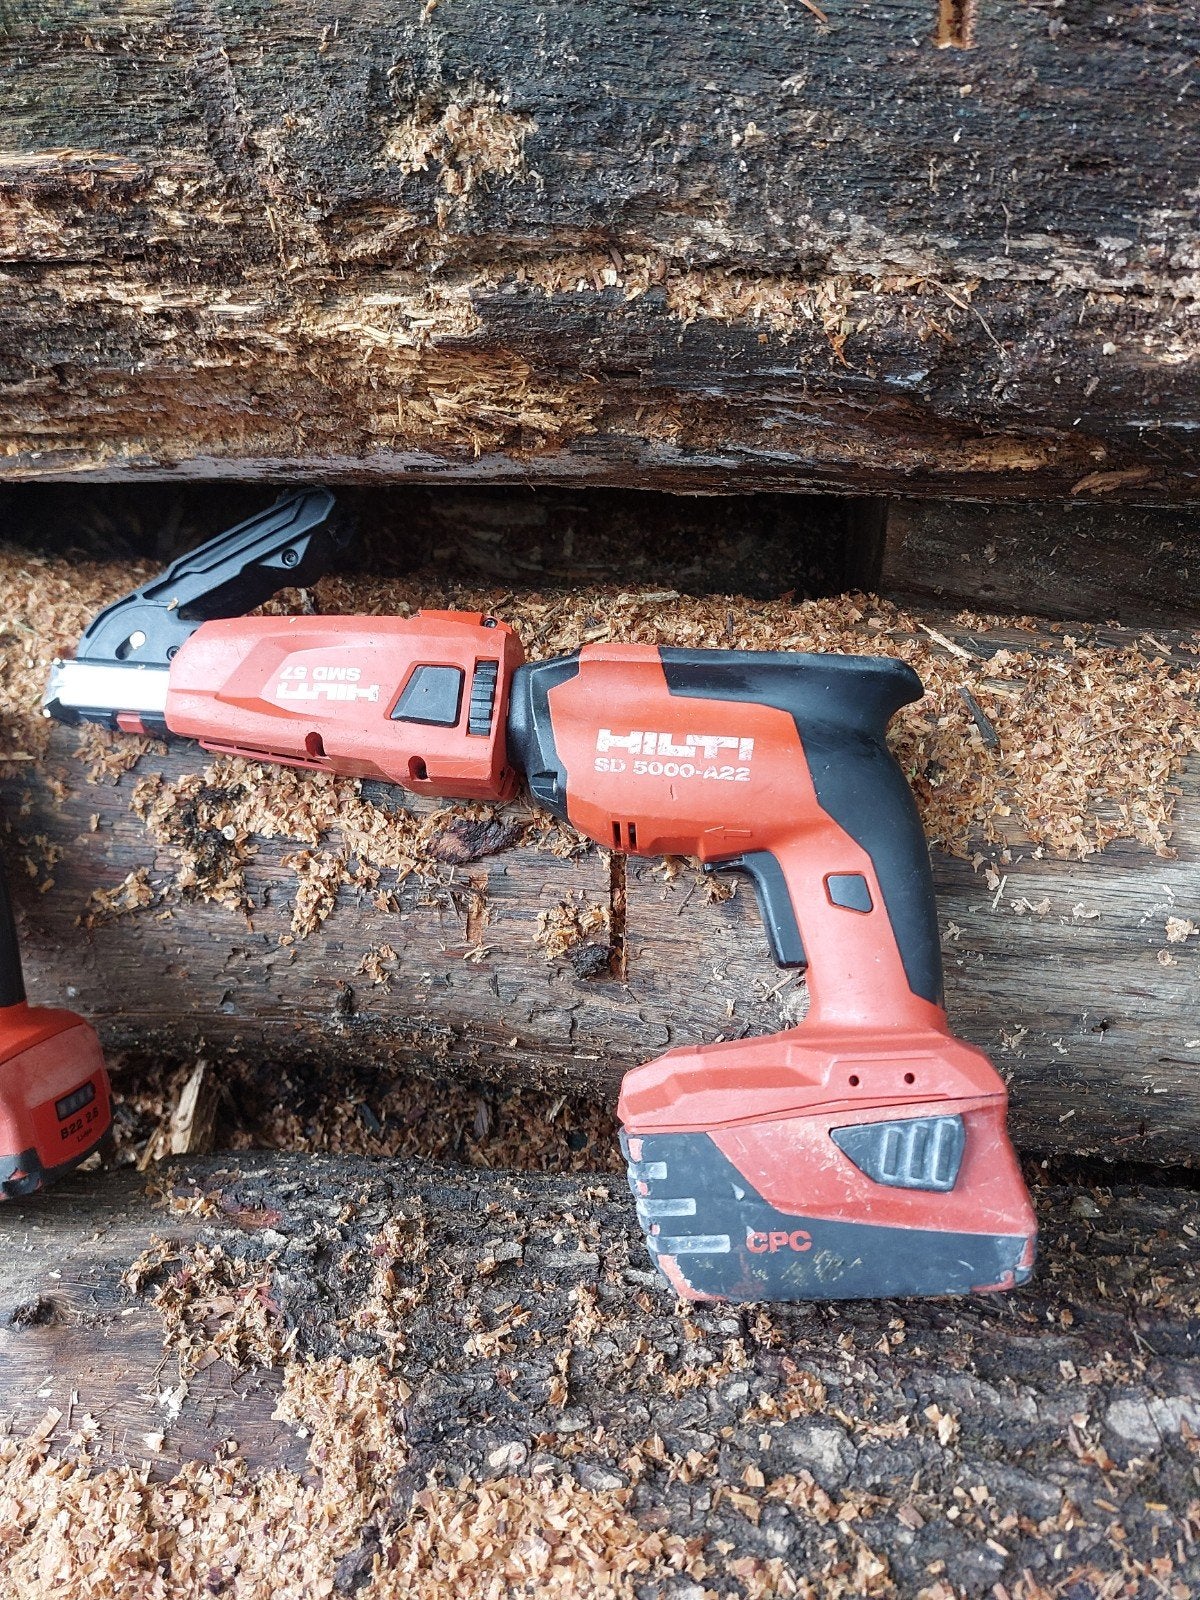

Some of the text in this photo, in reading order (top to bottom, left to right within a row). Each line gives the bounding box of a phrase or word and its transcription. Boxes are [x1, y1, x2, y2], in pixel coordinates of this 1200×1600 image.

[280, 666, 361, 681] SMD 57
[275, 682, 380, 702] HILTI
[596, 729, 755, 761] HILTI
[594, 757, 751, 782] SD 5000-A22
[60, 1117, 83, 1140] B22
[746, 1230, 812, 1253] CPC
